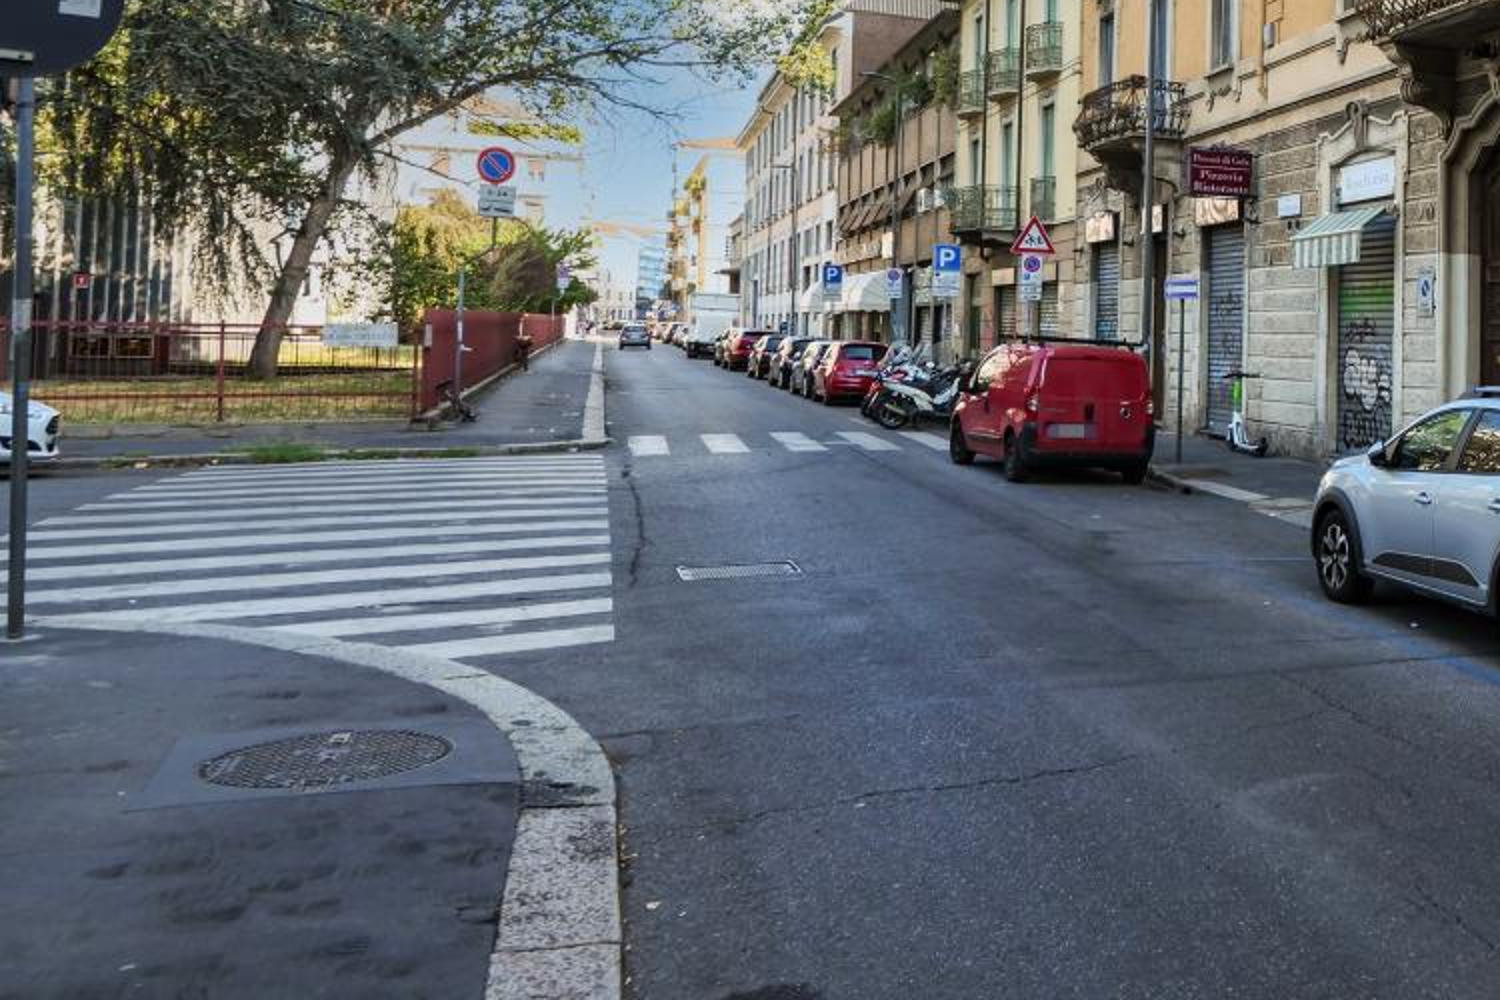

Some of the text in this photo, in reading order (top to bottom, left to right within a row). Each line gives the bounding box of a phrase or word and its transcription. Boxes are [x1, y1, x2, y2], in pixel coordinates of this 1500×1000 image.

[1200, 169, 1243, 181] Pizzeria
[1193, 180, 1249, 193] Ristorante
[940, 247, 956, 267] P
[827, 267, 839, 281] P
